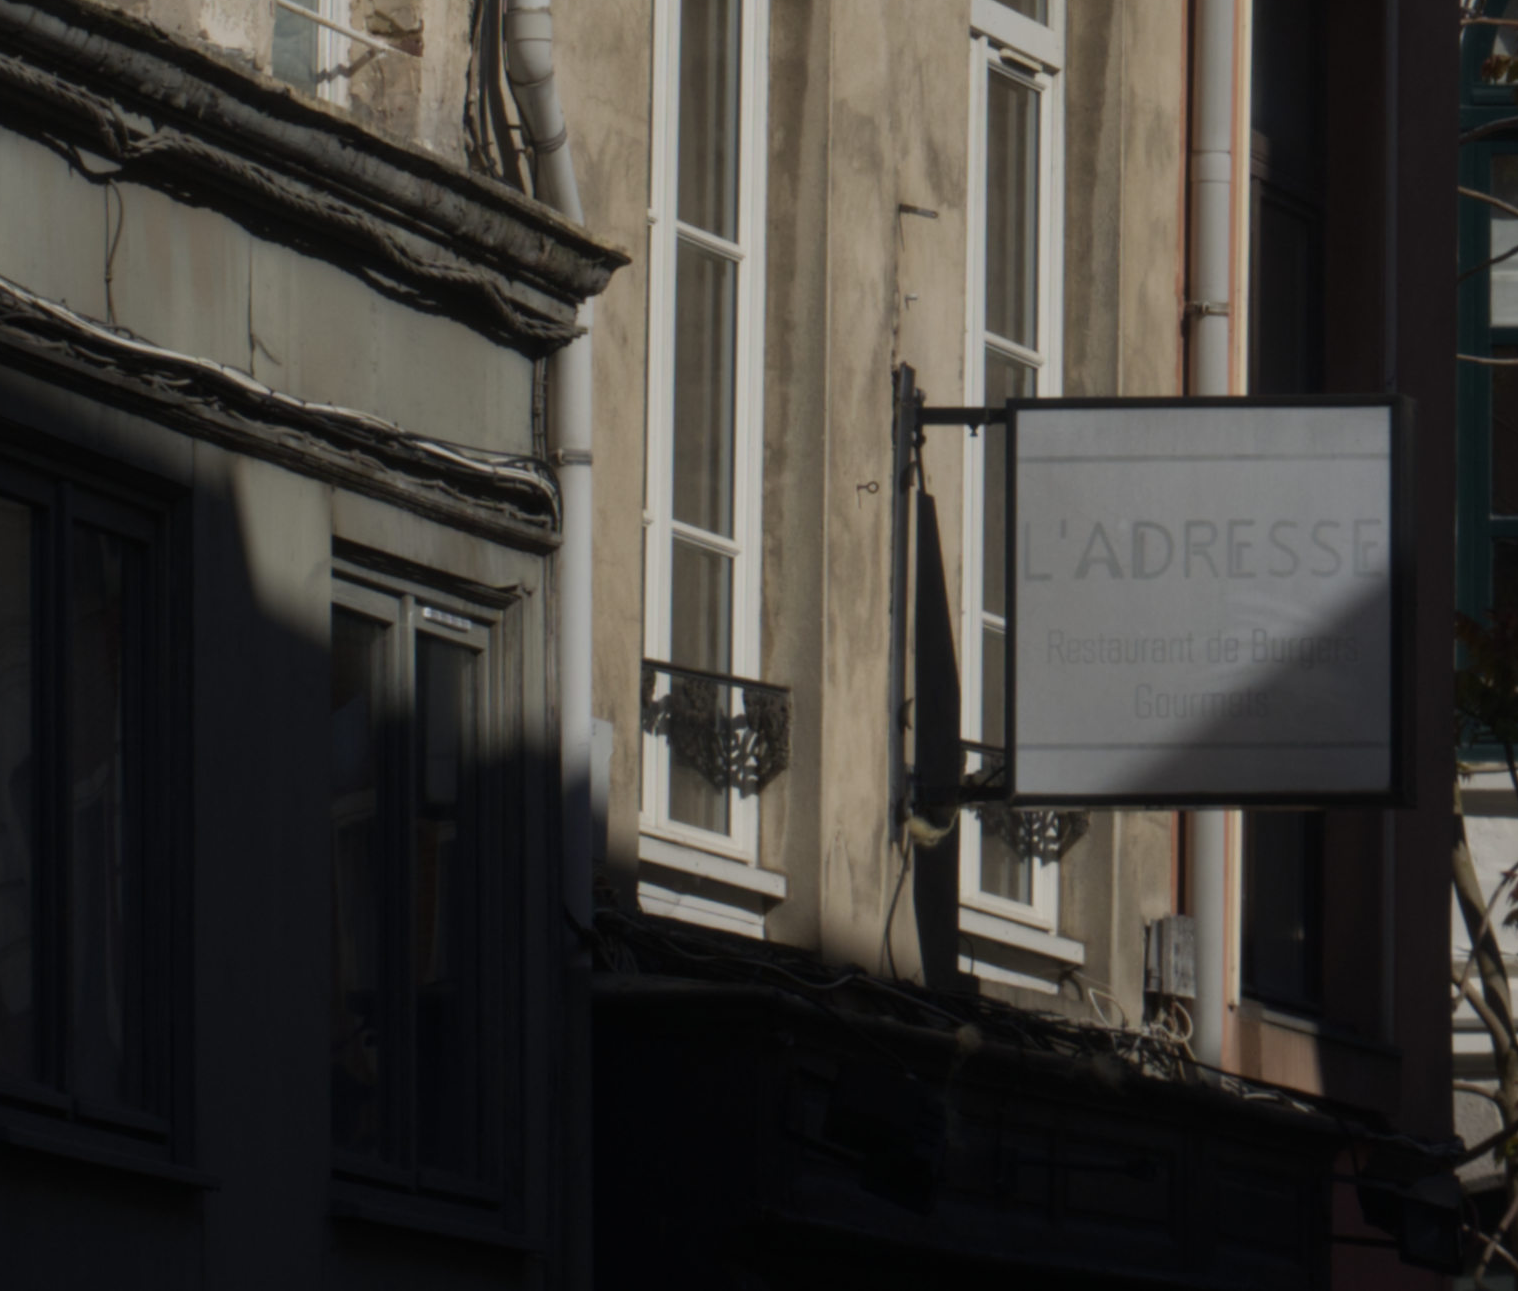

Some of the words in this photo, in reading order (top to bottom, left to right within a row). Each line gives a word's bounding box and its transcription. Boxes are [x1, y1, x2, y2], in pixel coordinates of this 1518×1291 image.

[1023, 518, 1383, 582] L'ADRESSE
[1046, 628, 1195, 666] Restaurant
[1206, 628, 1240, 664] de
[1251, 627, 1360, 670] Burgers
[1134, 682, 1269, 720] Gourmets
